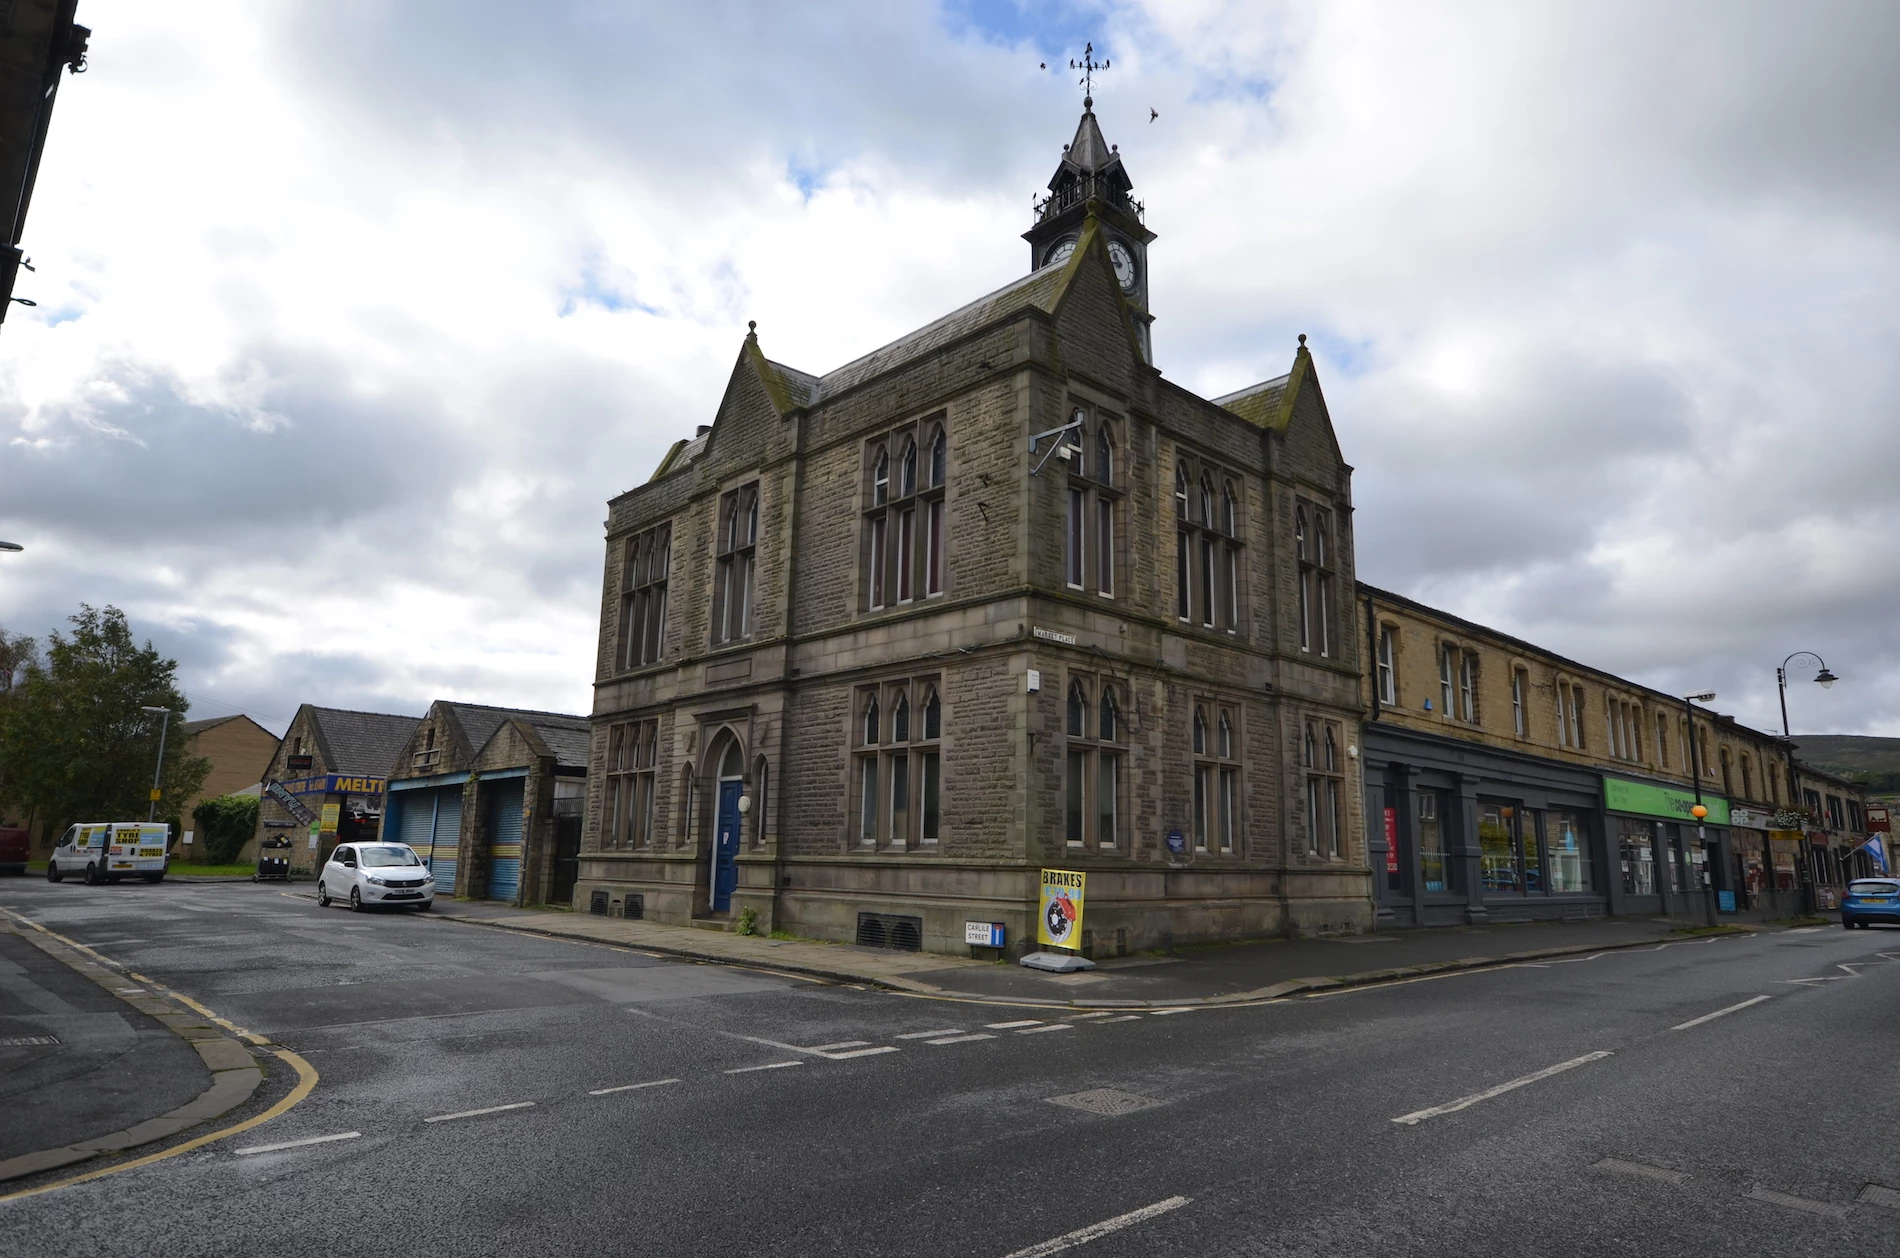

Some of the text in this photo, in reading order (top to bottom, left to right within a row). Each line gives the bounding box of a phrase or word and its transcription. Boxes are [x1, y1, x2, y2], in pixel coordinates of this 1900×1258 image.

[1038, 630, 1074, 643] MARKET PLACE
[1043, 871, 1082, 887] BRAKES
[967, 924, 989, 932] CARLILE
[968, 933, 988, 941] STREET
